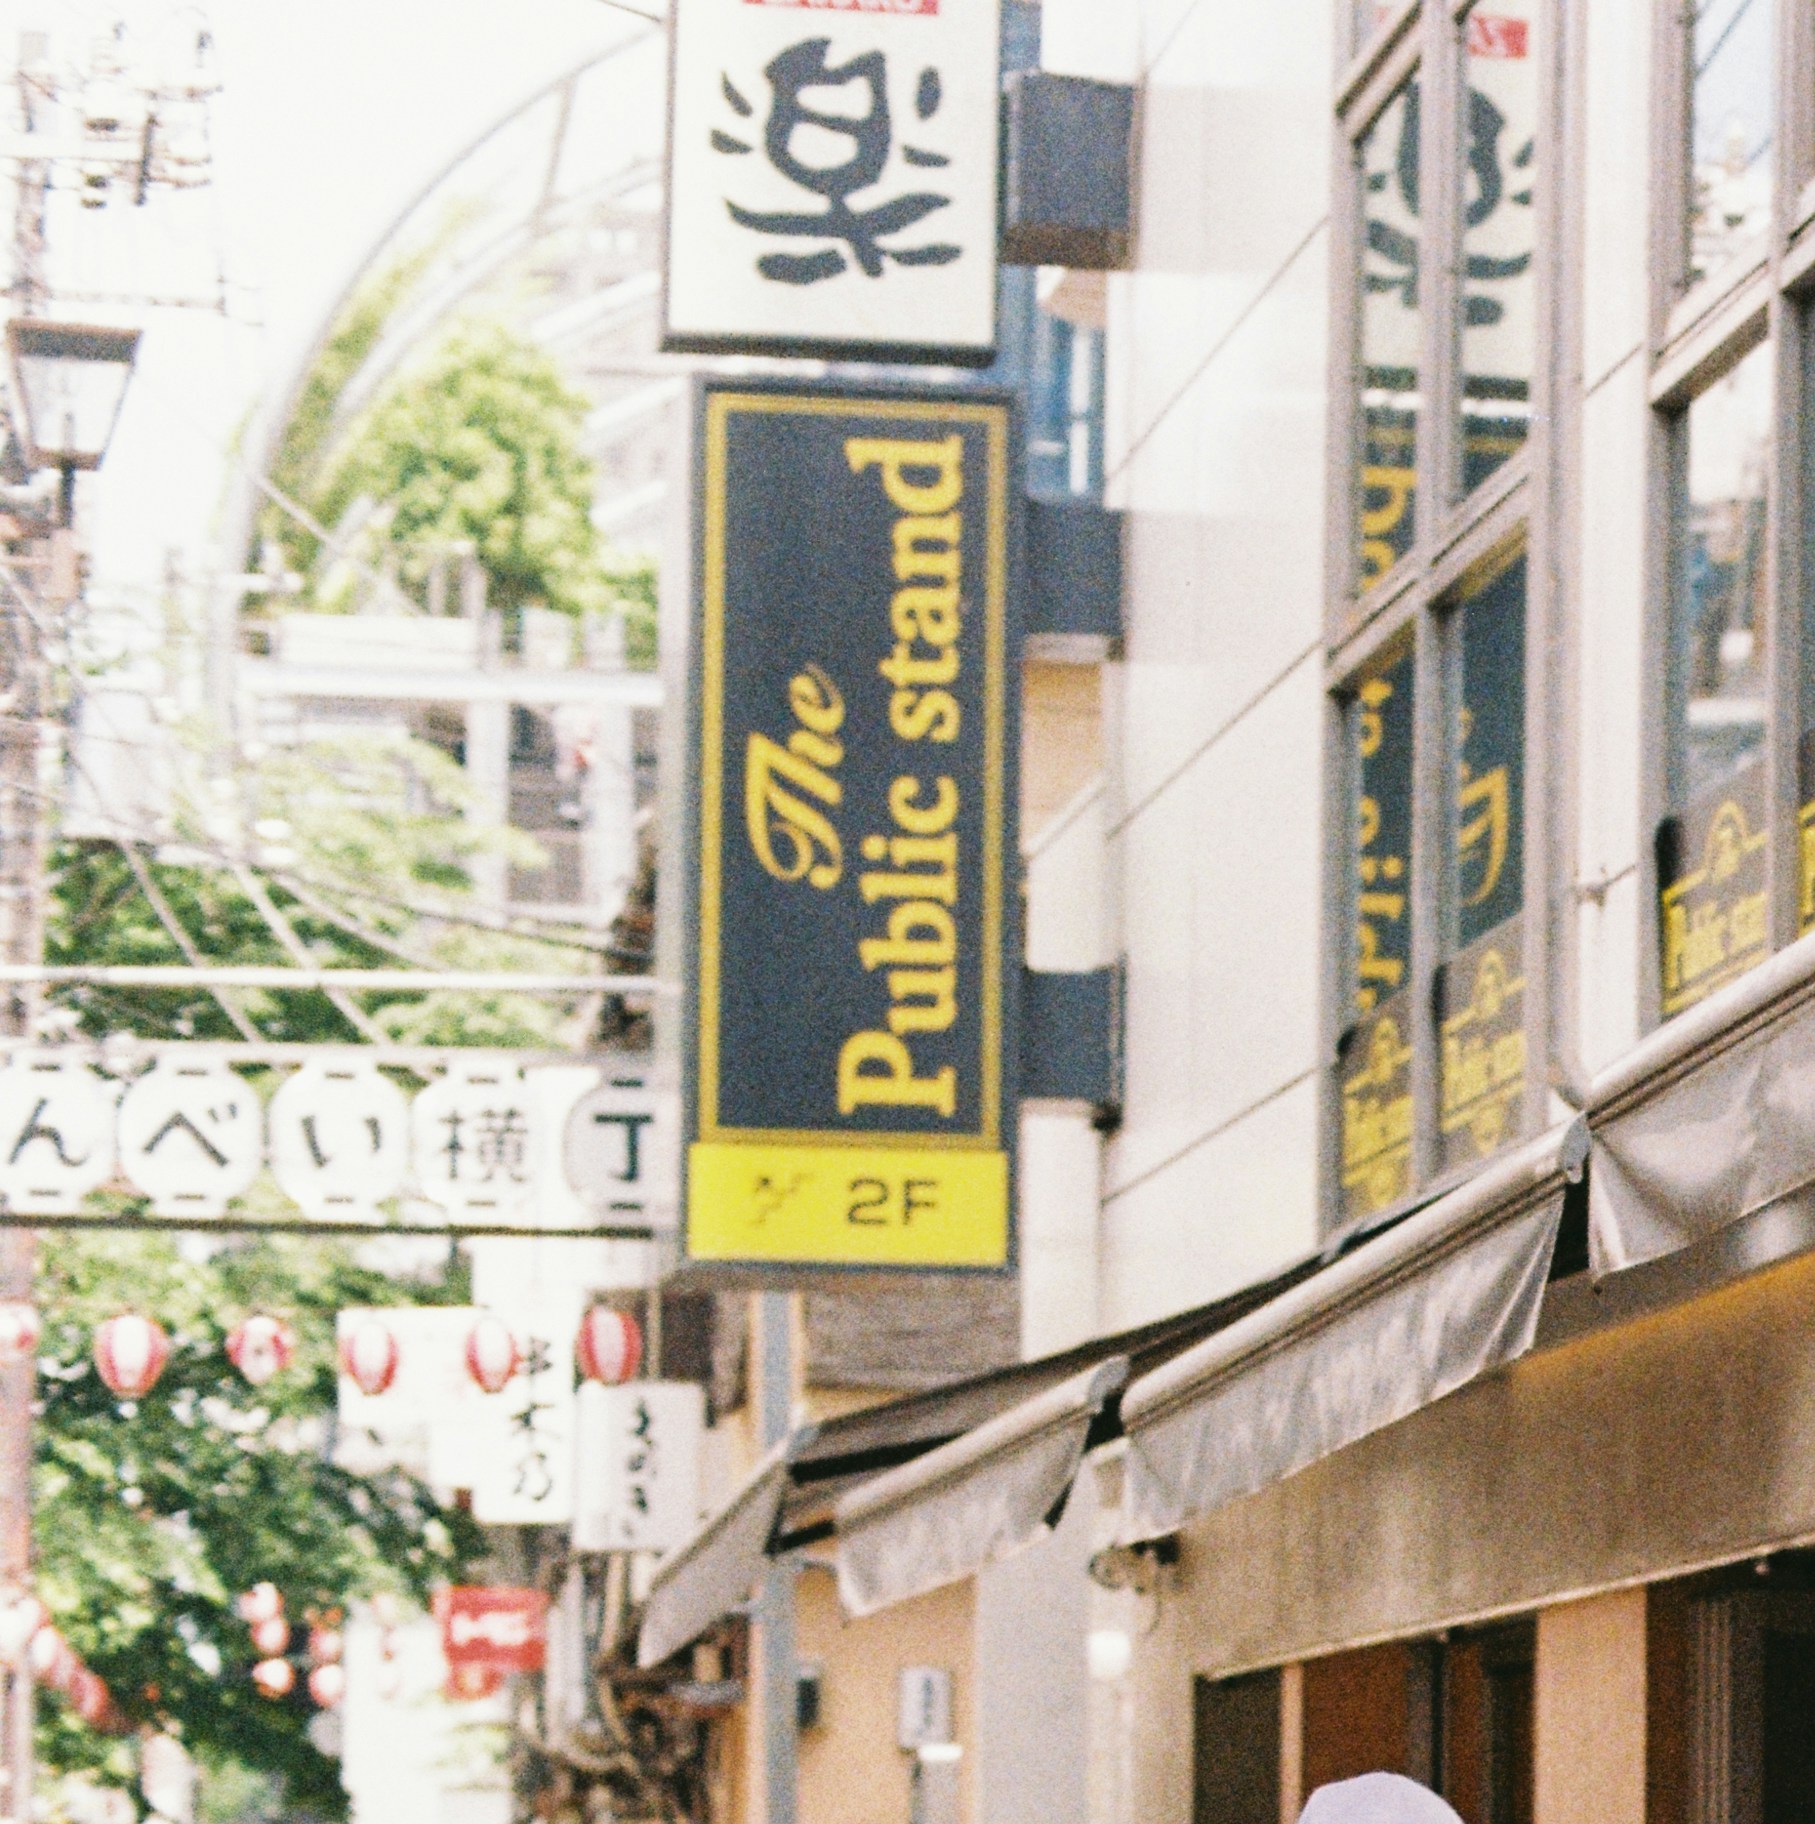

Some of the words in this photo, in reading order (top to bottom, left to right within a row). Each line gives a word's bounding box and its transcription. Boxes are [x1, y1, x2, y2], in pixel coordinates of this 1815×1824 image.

[844, 434, 963, 743] stand
[744, 663, 844, 890] The
[837, 776, 959, 1117] Public
[848, 1177, 938, 1226] 2F
